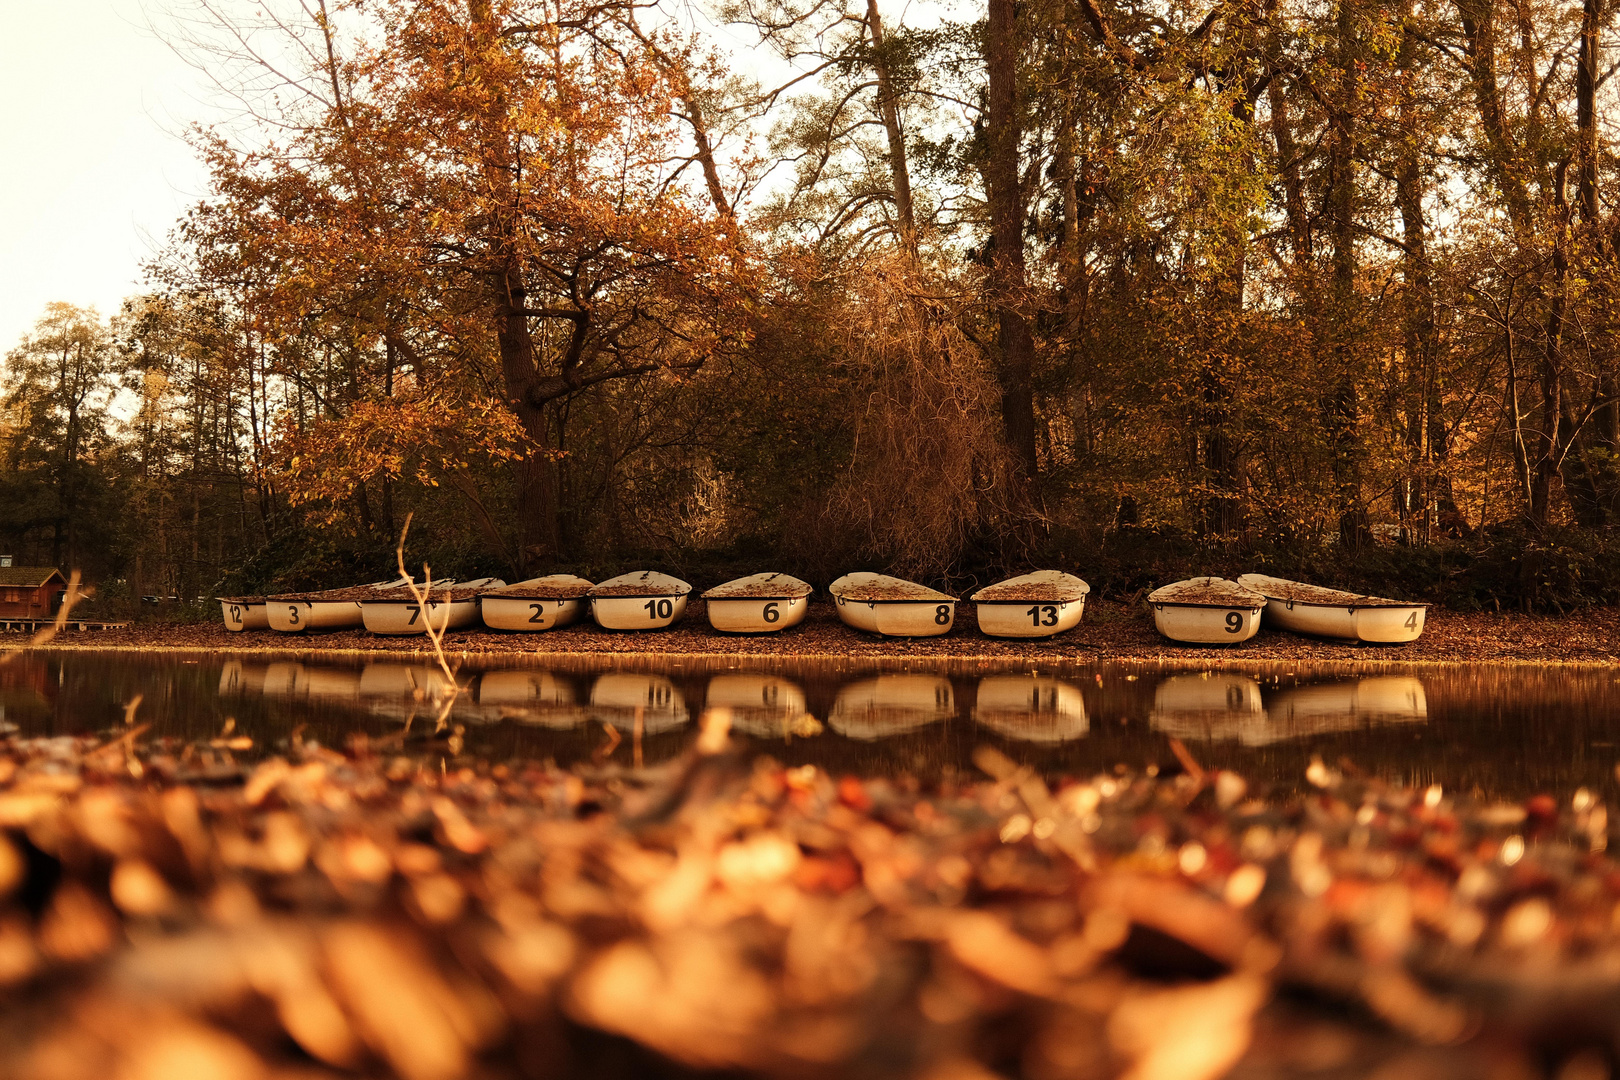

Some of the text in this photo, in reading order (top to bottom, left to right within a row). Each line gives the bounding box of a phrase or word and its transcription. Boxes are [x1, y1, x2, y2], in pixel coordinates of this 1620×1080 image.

[229, 605, 243, 624] 12
[288, 605, 300, 625] 3
[406, 605, 422, 626] 7
[528, 603, 545, 624] 2
[644, 599, 673, 620] 10
[762, 602, 780, 623] 6
[934, 604, 950, 626] 8
[1026, 605, 1058, 627] 13
[1224, 611, 1244, 634] 9
[1404, 611, 1418, 633] 4
